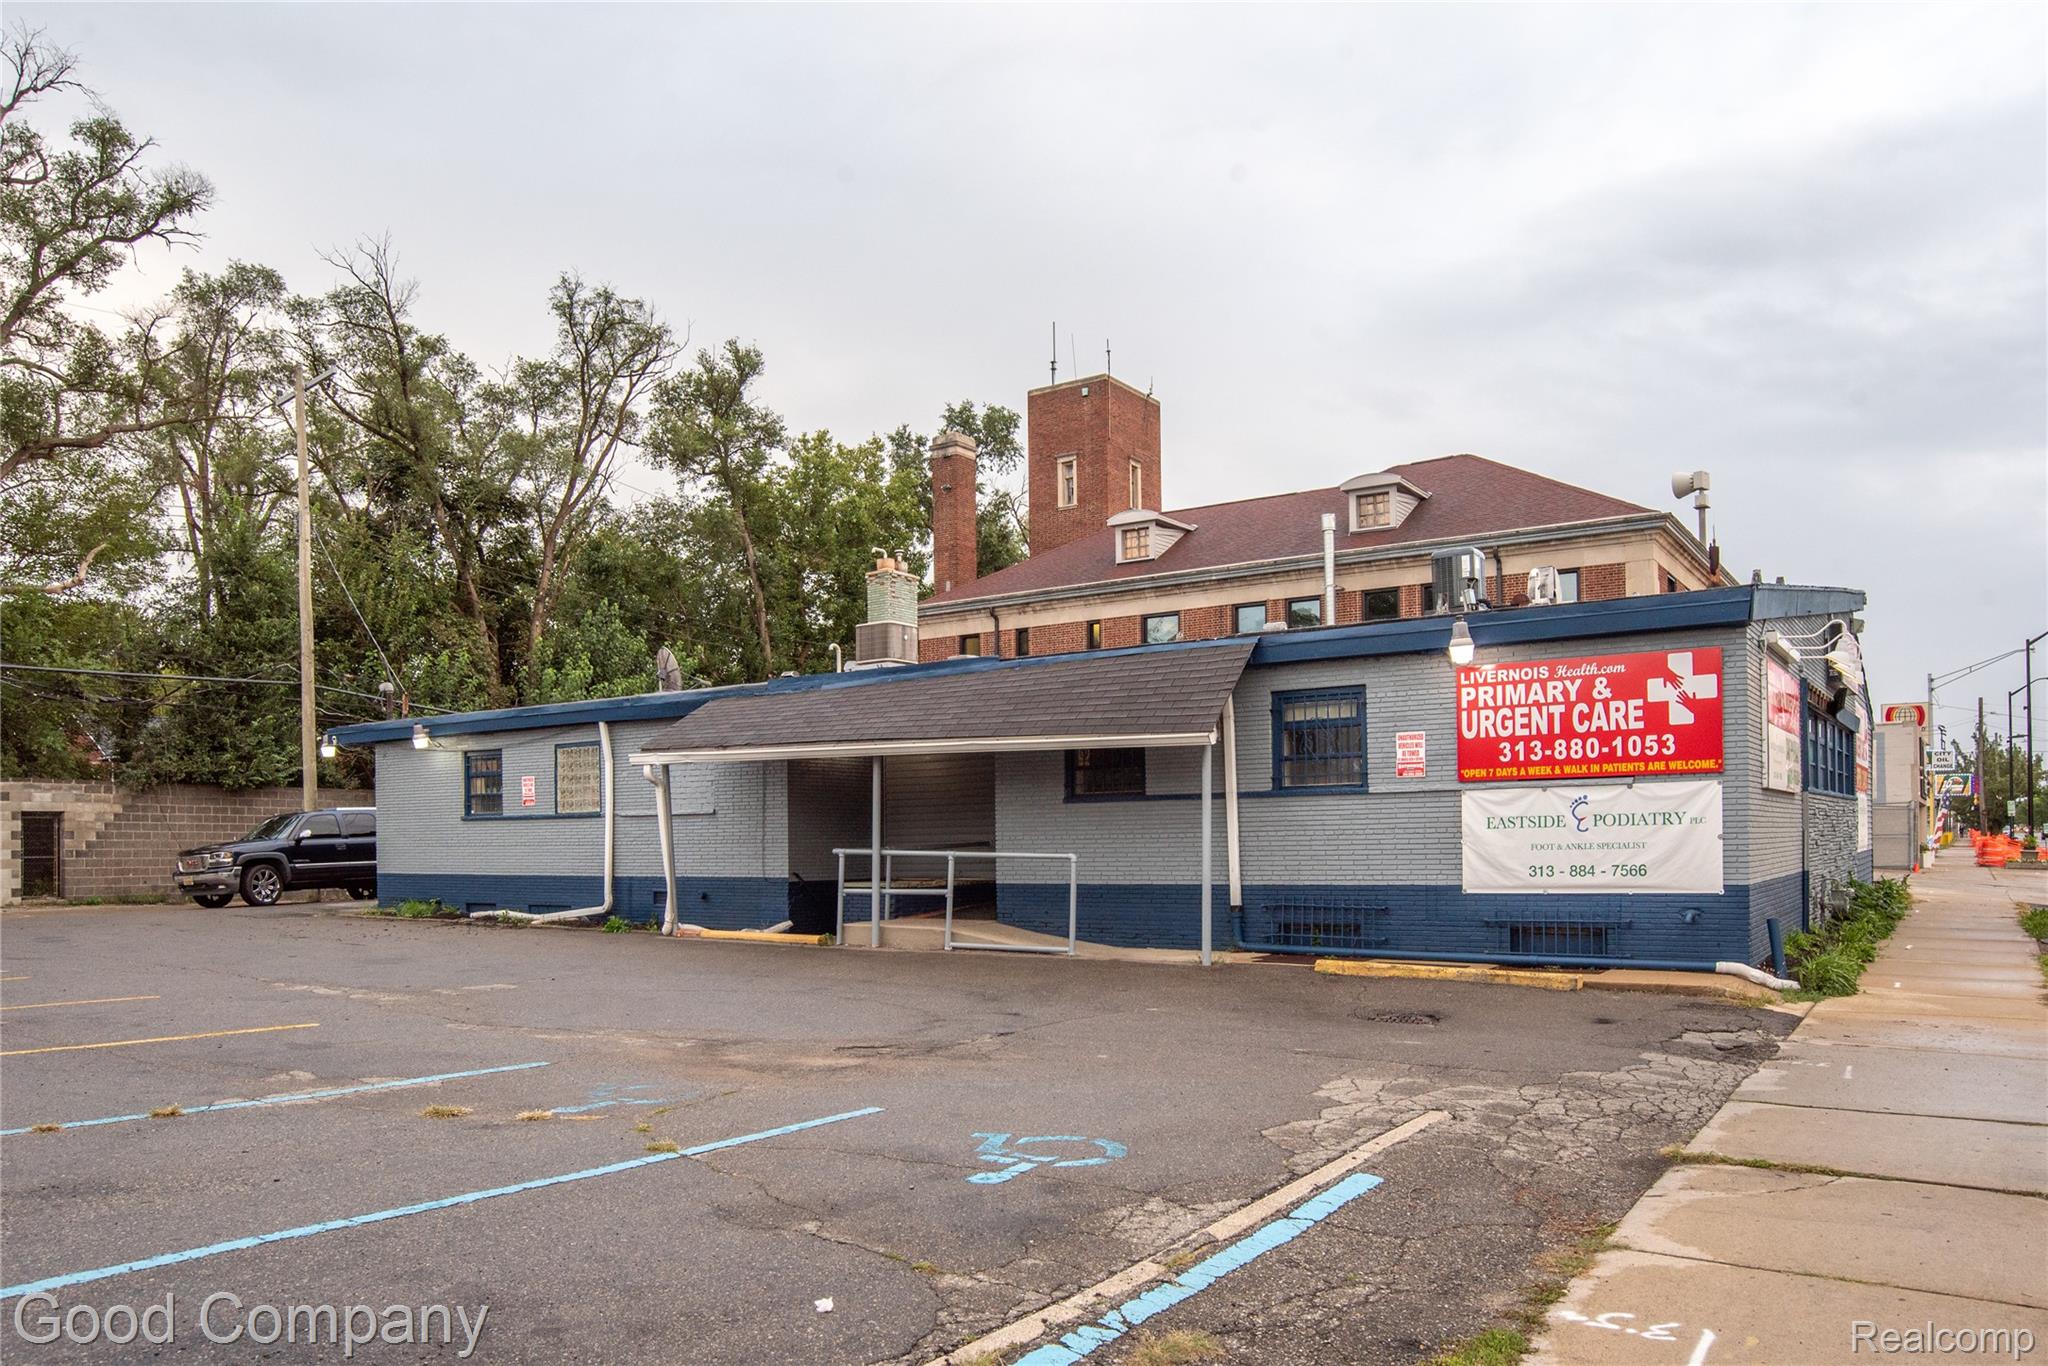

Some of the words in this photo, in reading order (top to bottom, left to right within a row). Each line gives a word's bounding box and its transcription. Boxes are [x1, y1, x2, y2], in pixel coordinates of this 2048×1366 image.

[1460, 666, 1549, 685] LIVERNOIS
[1553, 663, 1626, 679] Health.com
[1461, 679, 1583, 708] PRIMARY
[1592, 677, 1612, 700] &
[1461, 704, 1565, 739] URGENT
[1572, 699, 1645, 735] CARE
[1499, 734, 1676, 762] 313-880-1053
[1489, 768, 1494, 777] 7
[1496, 767, 1518, 777] DAYS
[1520, 767, 1527, 776] A
[1528, 765, 1552, 776] WEEK
[1554, 765, 1561, 774] &
[1564, 764, 1589, 774] WALK
[1590, 764, 1600, 773] IN
[1602, 762, 1645, 773] PATIENTS
[1648, 761, 1666, 771] ARE
[1486, 815, 1566, 830] EASTSIDE
[1593, 811, 1687, 827] PODIATRY
[1531, 843, 1555, 851] FOOT
[1565, 842, 1595, 850] ANKLE
[1597, 841, 1647, 850] SPECIALIST
[1529, 865, 1554, 877] 313
[1569, 864, 1595, 877] 884
[1611, 864, 1648, 877] 7566
